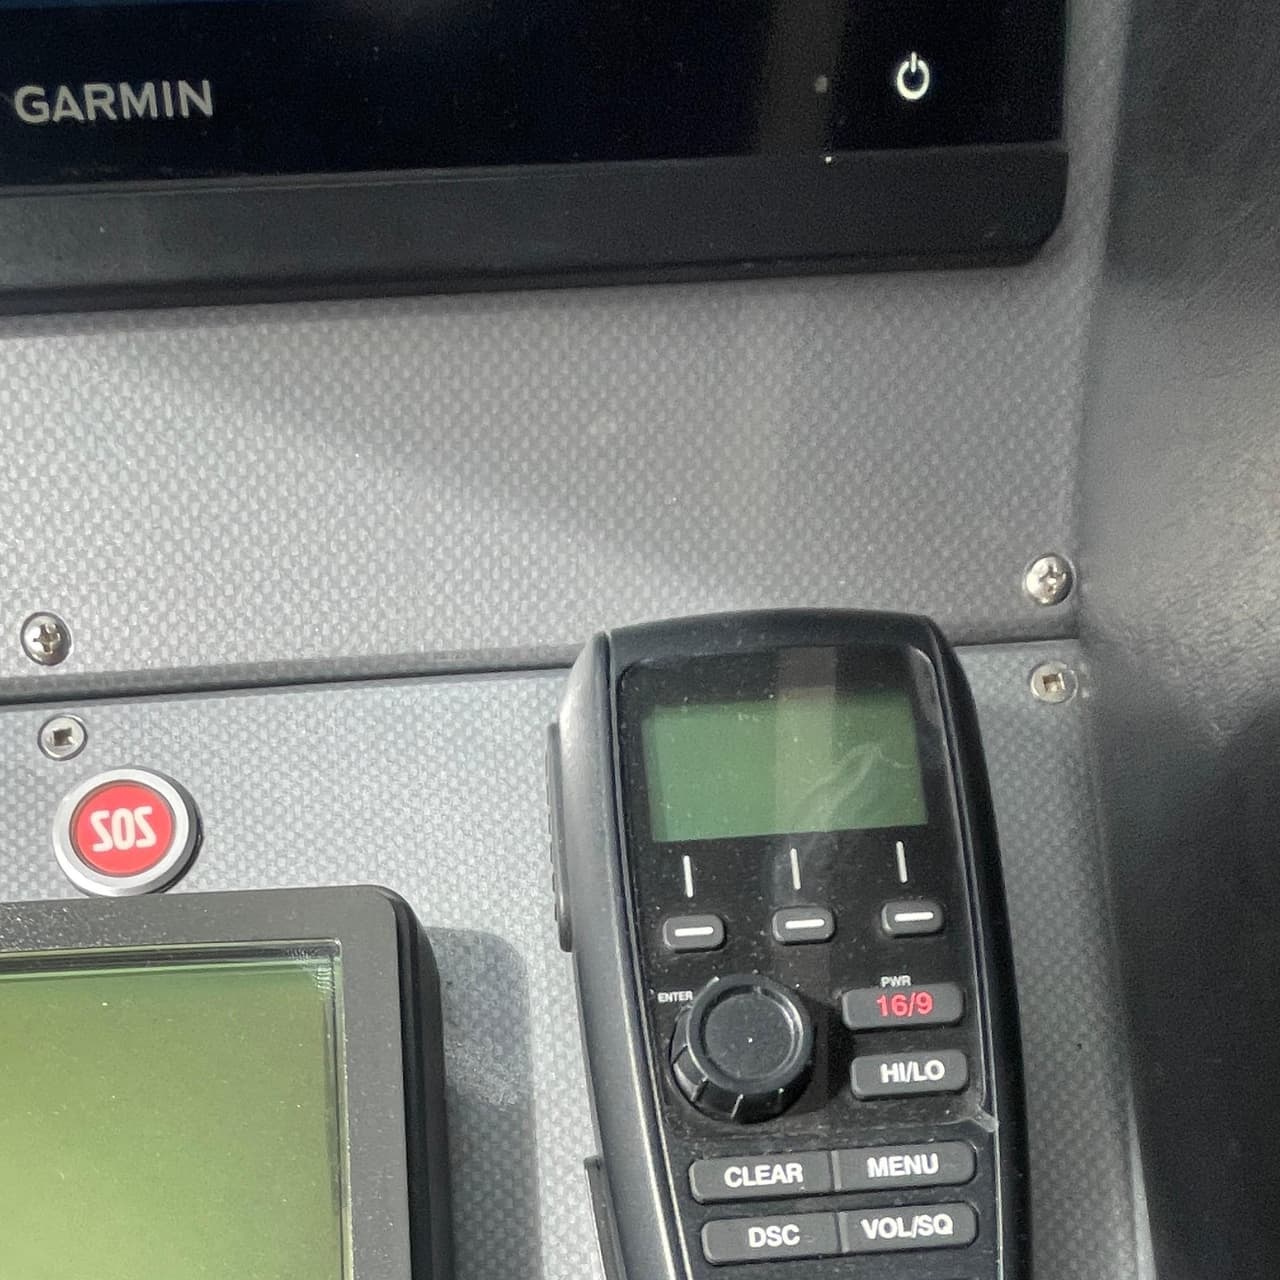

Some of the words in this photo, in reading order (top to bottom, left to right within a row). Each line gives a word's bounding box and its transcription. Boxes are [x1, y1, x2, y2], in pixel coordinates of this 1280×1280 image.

[14, 79, 213, 123] GARMIN
[90, 806, 157, 852] SOS
[881, 975, 911, 987] PWR
[658, 991, 693, 1003] ENTER
[876, 993, 934, 1017] 16/9
[880, 1060, 946, 1083] HI/LO
[723, 1162, 803, 1188] CLEAR
[867, 1153, 939, 1178] MENU
[748, 1223, 800, 1248] DSC
[861, 1213, 953, 1240] VOL/SQ
